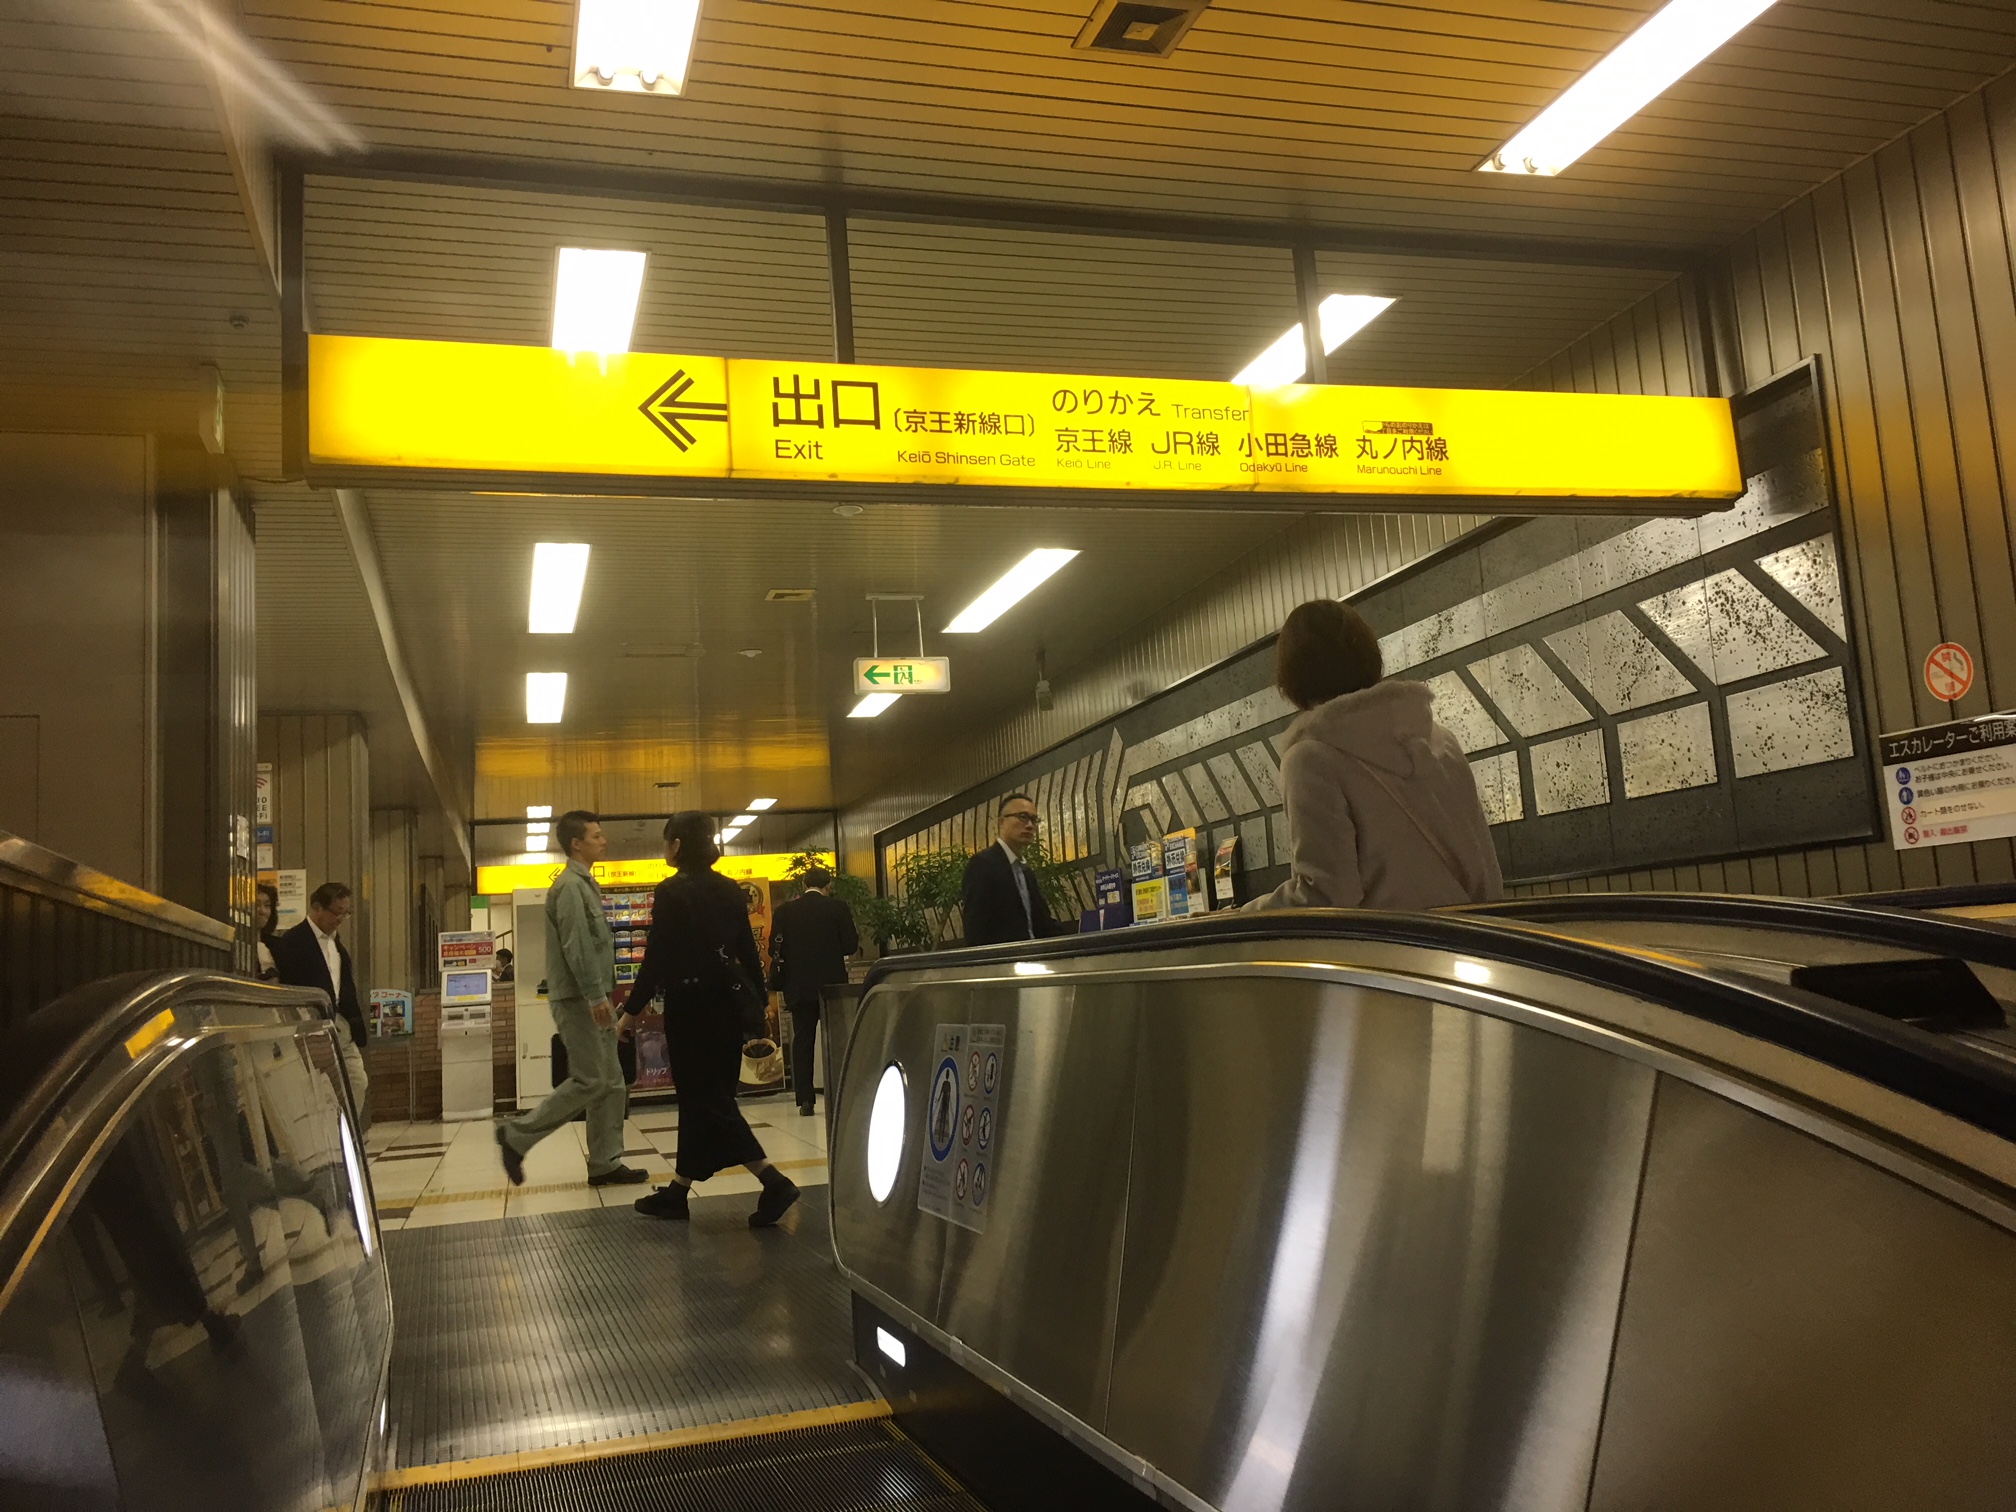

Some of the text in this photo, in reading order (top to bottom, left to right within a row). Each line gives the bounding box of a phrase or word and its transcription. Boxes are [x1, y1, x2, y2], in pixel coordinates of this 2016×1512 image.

[772, 374, 881, 430] 出口
[1052, 388, 1249, 422] のりかえ Transfer
[774, 439, 824, 461] Exit
[1055, 428, 1450, 462] 京王線 JR線 小田急線 丸ノ内線
[935, 451, 996, 466] Shinsen
[1000, 453, 1036, 468] Gate
[1086, 459, 1112, 470] Line
[1178, 461, 1202, 471] Line
[1285, 462, 1309, 473] Line
[1356, 464, 1418, 476] Marunouchi
[1420, 465, 1443, 476] Line
